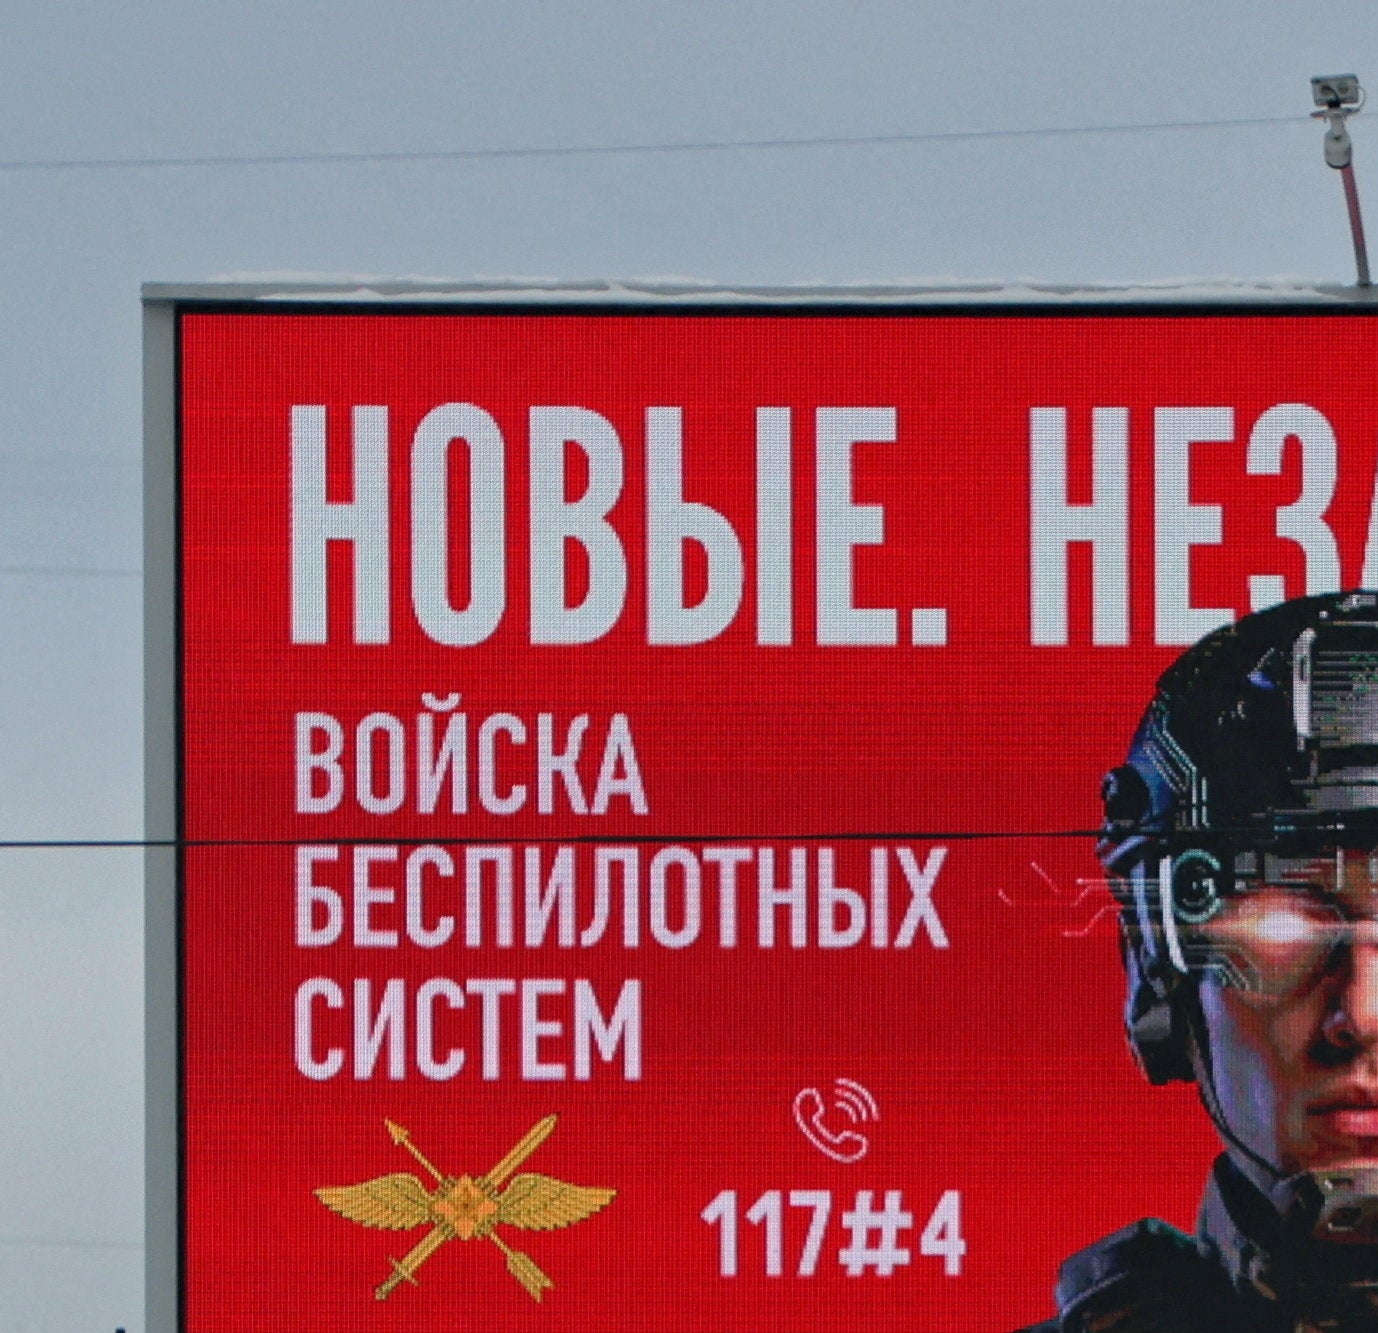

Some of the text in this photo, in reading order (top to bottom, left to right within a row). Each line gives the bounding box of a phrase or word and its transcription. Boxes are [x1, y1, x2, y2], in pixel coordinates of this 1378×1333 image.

[291, 403, 946, 646] НОВЫЕ.
[296, 693, 648, 814] ВОЙСКА
[297, 845, 948, 948] БЕСПИЛОТНЫХ
[295, 978, 640, 1080] СИСТЕМ
[702, 1191, 965, 1275] 117#4
